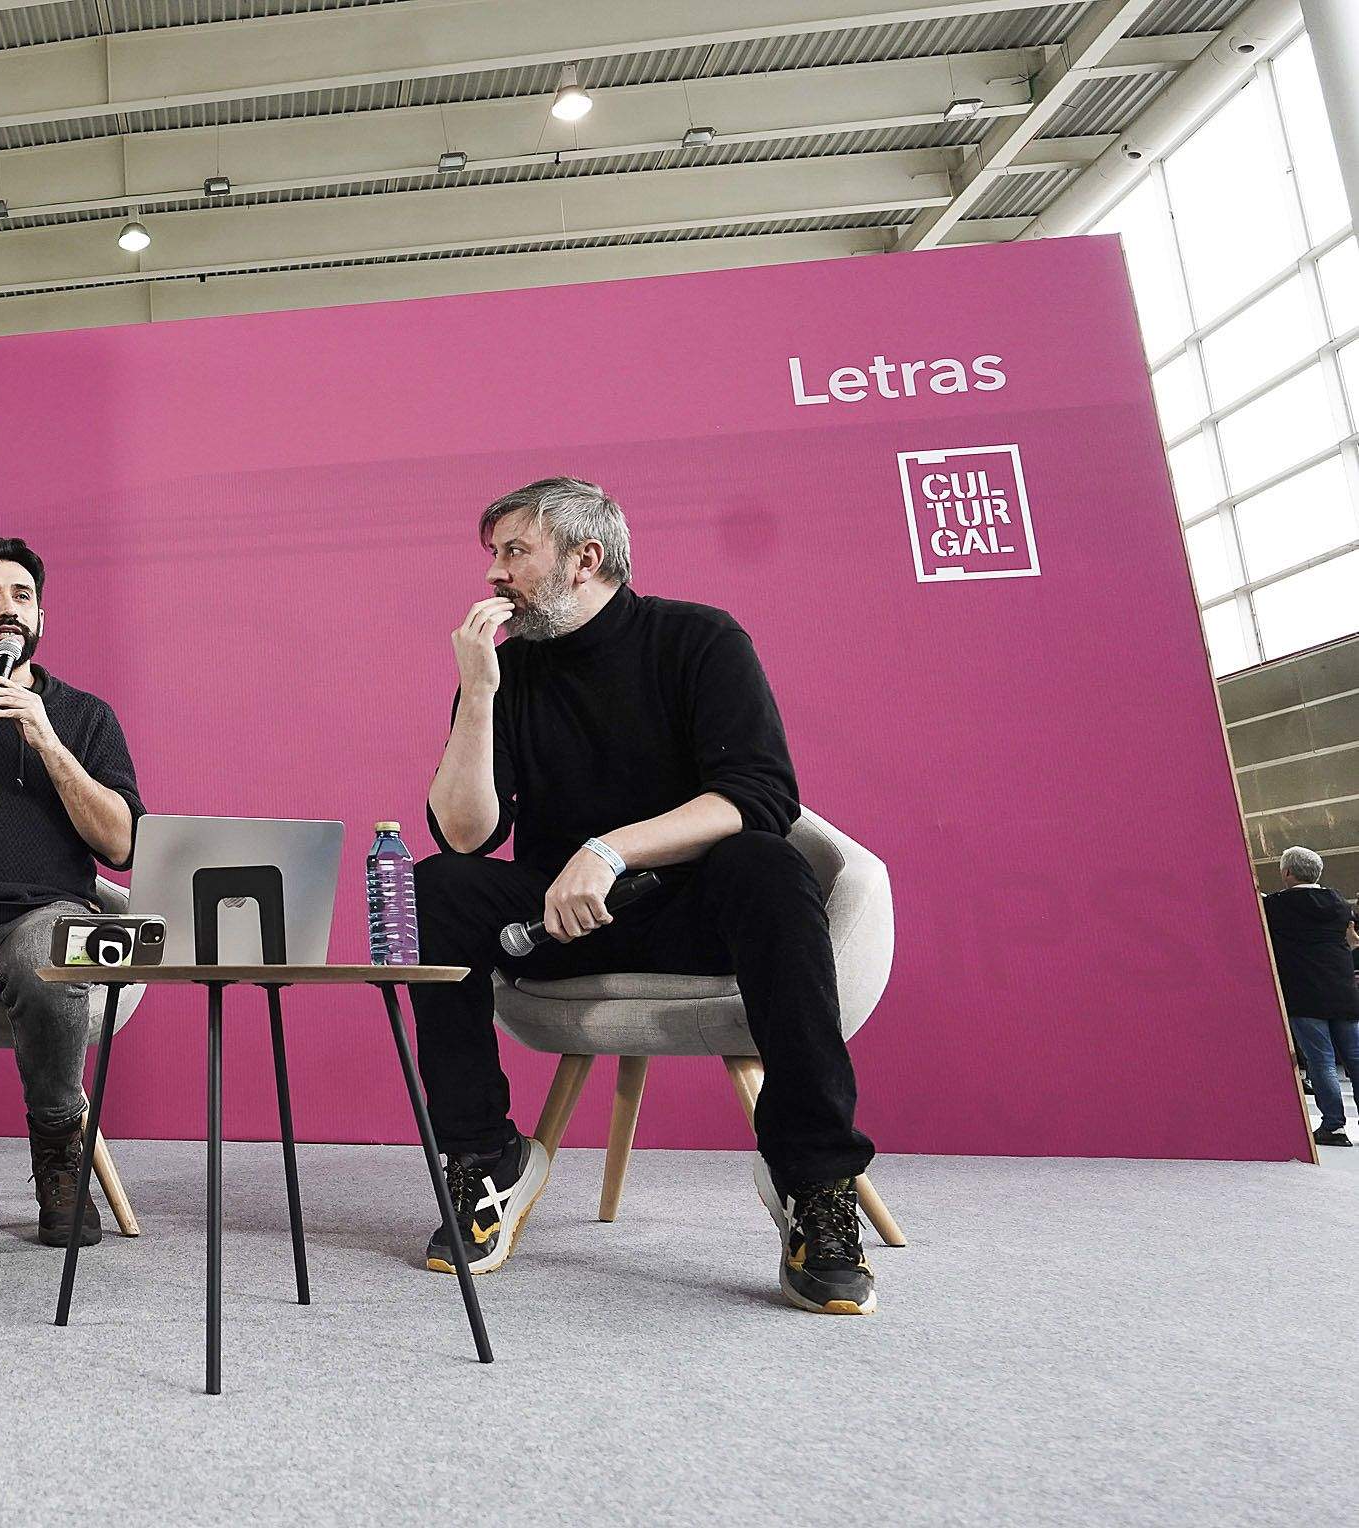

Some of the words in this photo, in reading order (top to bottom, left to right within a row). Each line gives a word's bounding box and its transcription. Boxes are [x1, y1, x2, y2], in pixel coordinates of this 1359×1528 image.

[789, 354, 1006, 406] Letras
[921, 471, 1005, 501] CUL
[927, 498, 1011, 529] TUR
[930, 527, 1014, 557] GAL
